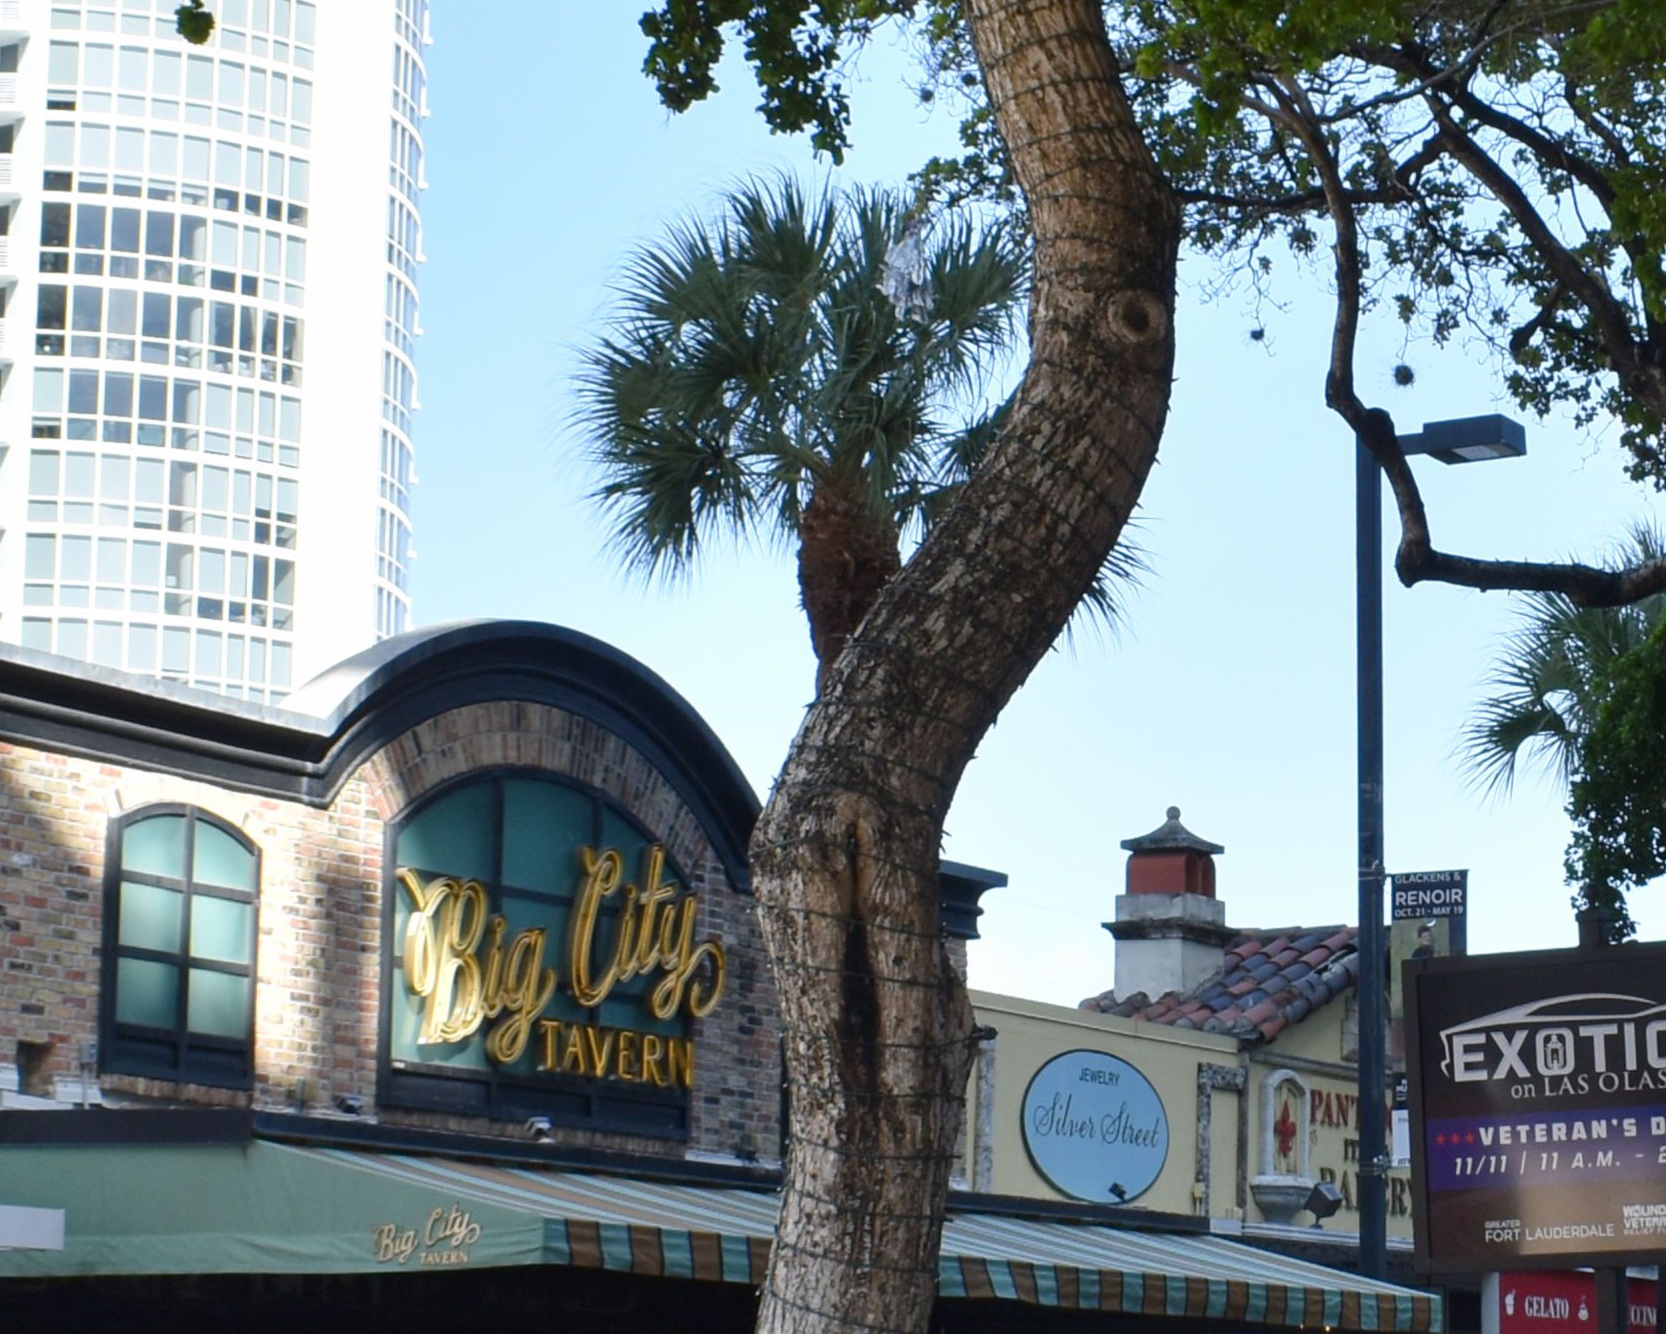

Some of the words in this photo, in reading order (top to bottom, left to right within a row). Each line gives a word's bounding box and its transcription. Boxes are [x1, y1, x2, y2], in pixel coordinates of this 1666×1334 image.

[1395, 872, 1451, 884] GLACKENS
[1453, 871, 1462, 881] &
[1395, 888, 1464, 907] RENOIR
[1394, 908, 1414, 918] OCT.
[1415, 907, 1425, 916] 21
[1432, 906, 1451, 916] MAY
[1453, 905, 1464, 915] 19
[395, 867, 557, 1064] Big
[568, 843, 727, 1021] City
[538, 1018, 695, 1089] TAVERN
[1079, 1067, 1121, 1086] JEWELRY
[1511, 1082, 1536, 1099] on
[1544, 1073, 1589, 1096] LAS
[1033, 1091, 1096, 1140] Silver
[1100, 1100, 1161, 1148] Street
[1478, 1117, 1638, 1146] VETERAN'S
[1454, 1154, 1507, 1176] 11/11
[1540, 1151, 1559, 1171] 11
[1571, 1149, 1622, 1169] A.M.
[374, 1224, 418, 1264] Big
[424, 1203, 481, 1247] City
[1484, 1229, 1521, 1243] FORT
[1525, 1223, 1615, 1241] LAUDERDALE
[419, 1250, 469, 1266] TAVERN
[1524, 1295, 1570, 1319] GELATO
